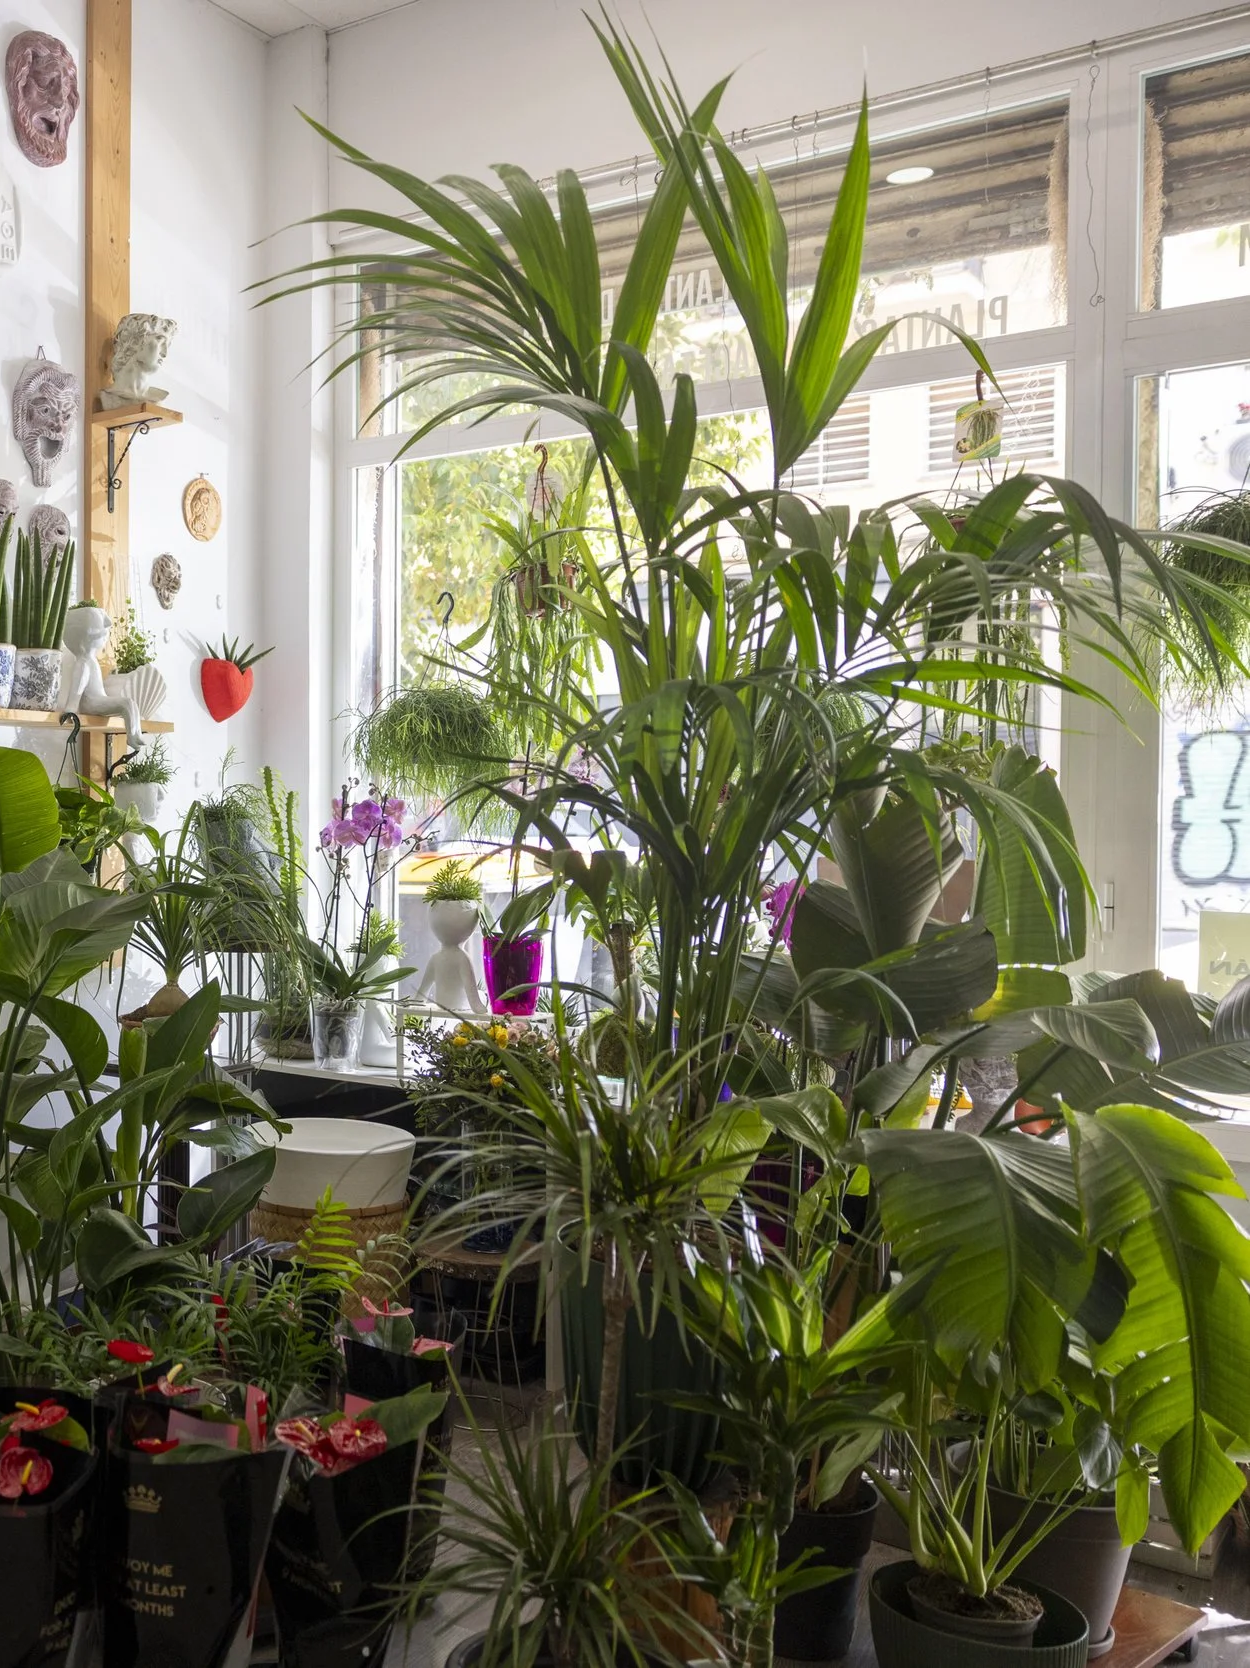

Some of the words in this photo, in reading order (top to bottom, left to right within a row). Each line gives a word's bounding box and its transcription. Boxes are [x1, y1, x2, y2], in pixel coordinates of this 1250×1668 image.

[123, 1557, 150, 1575] JOY
[152, 1563, 174, 1578] ME
[144, 1580, 187, 1599] LEAST
